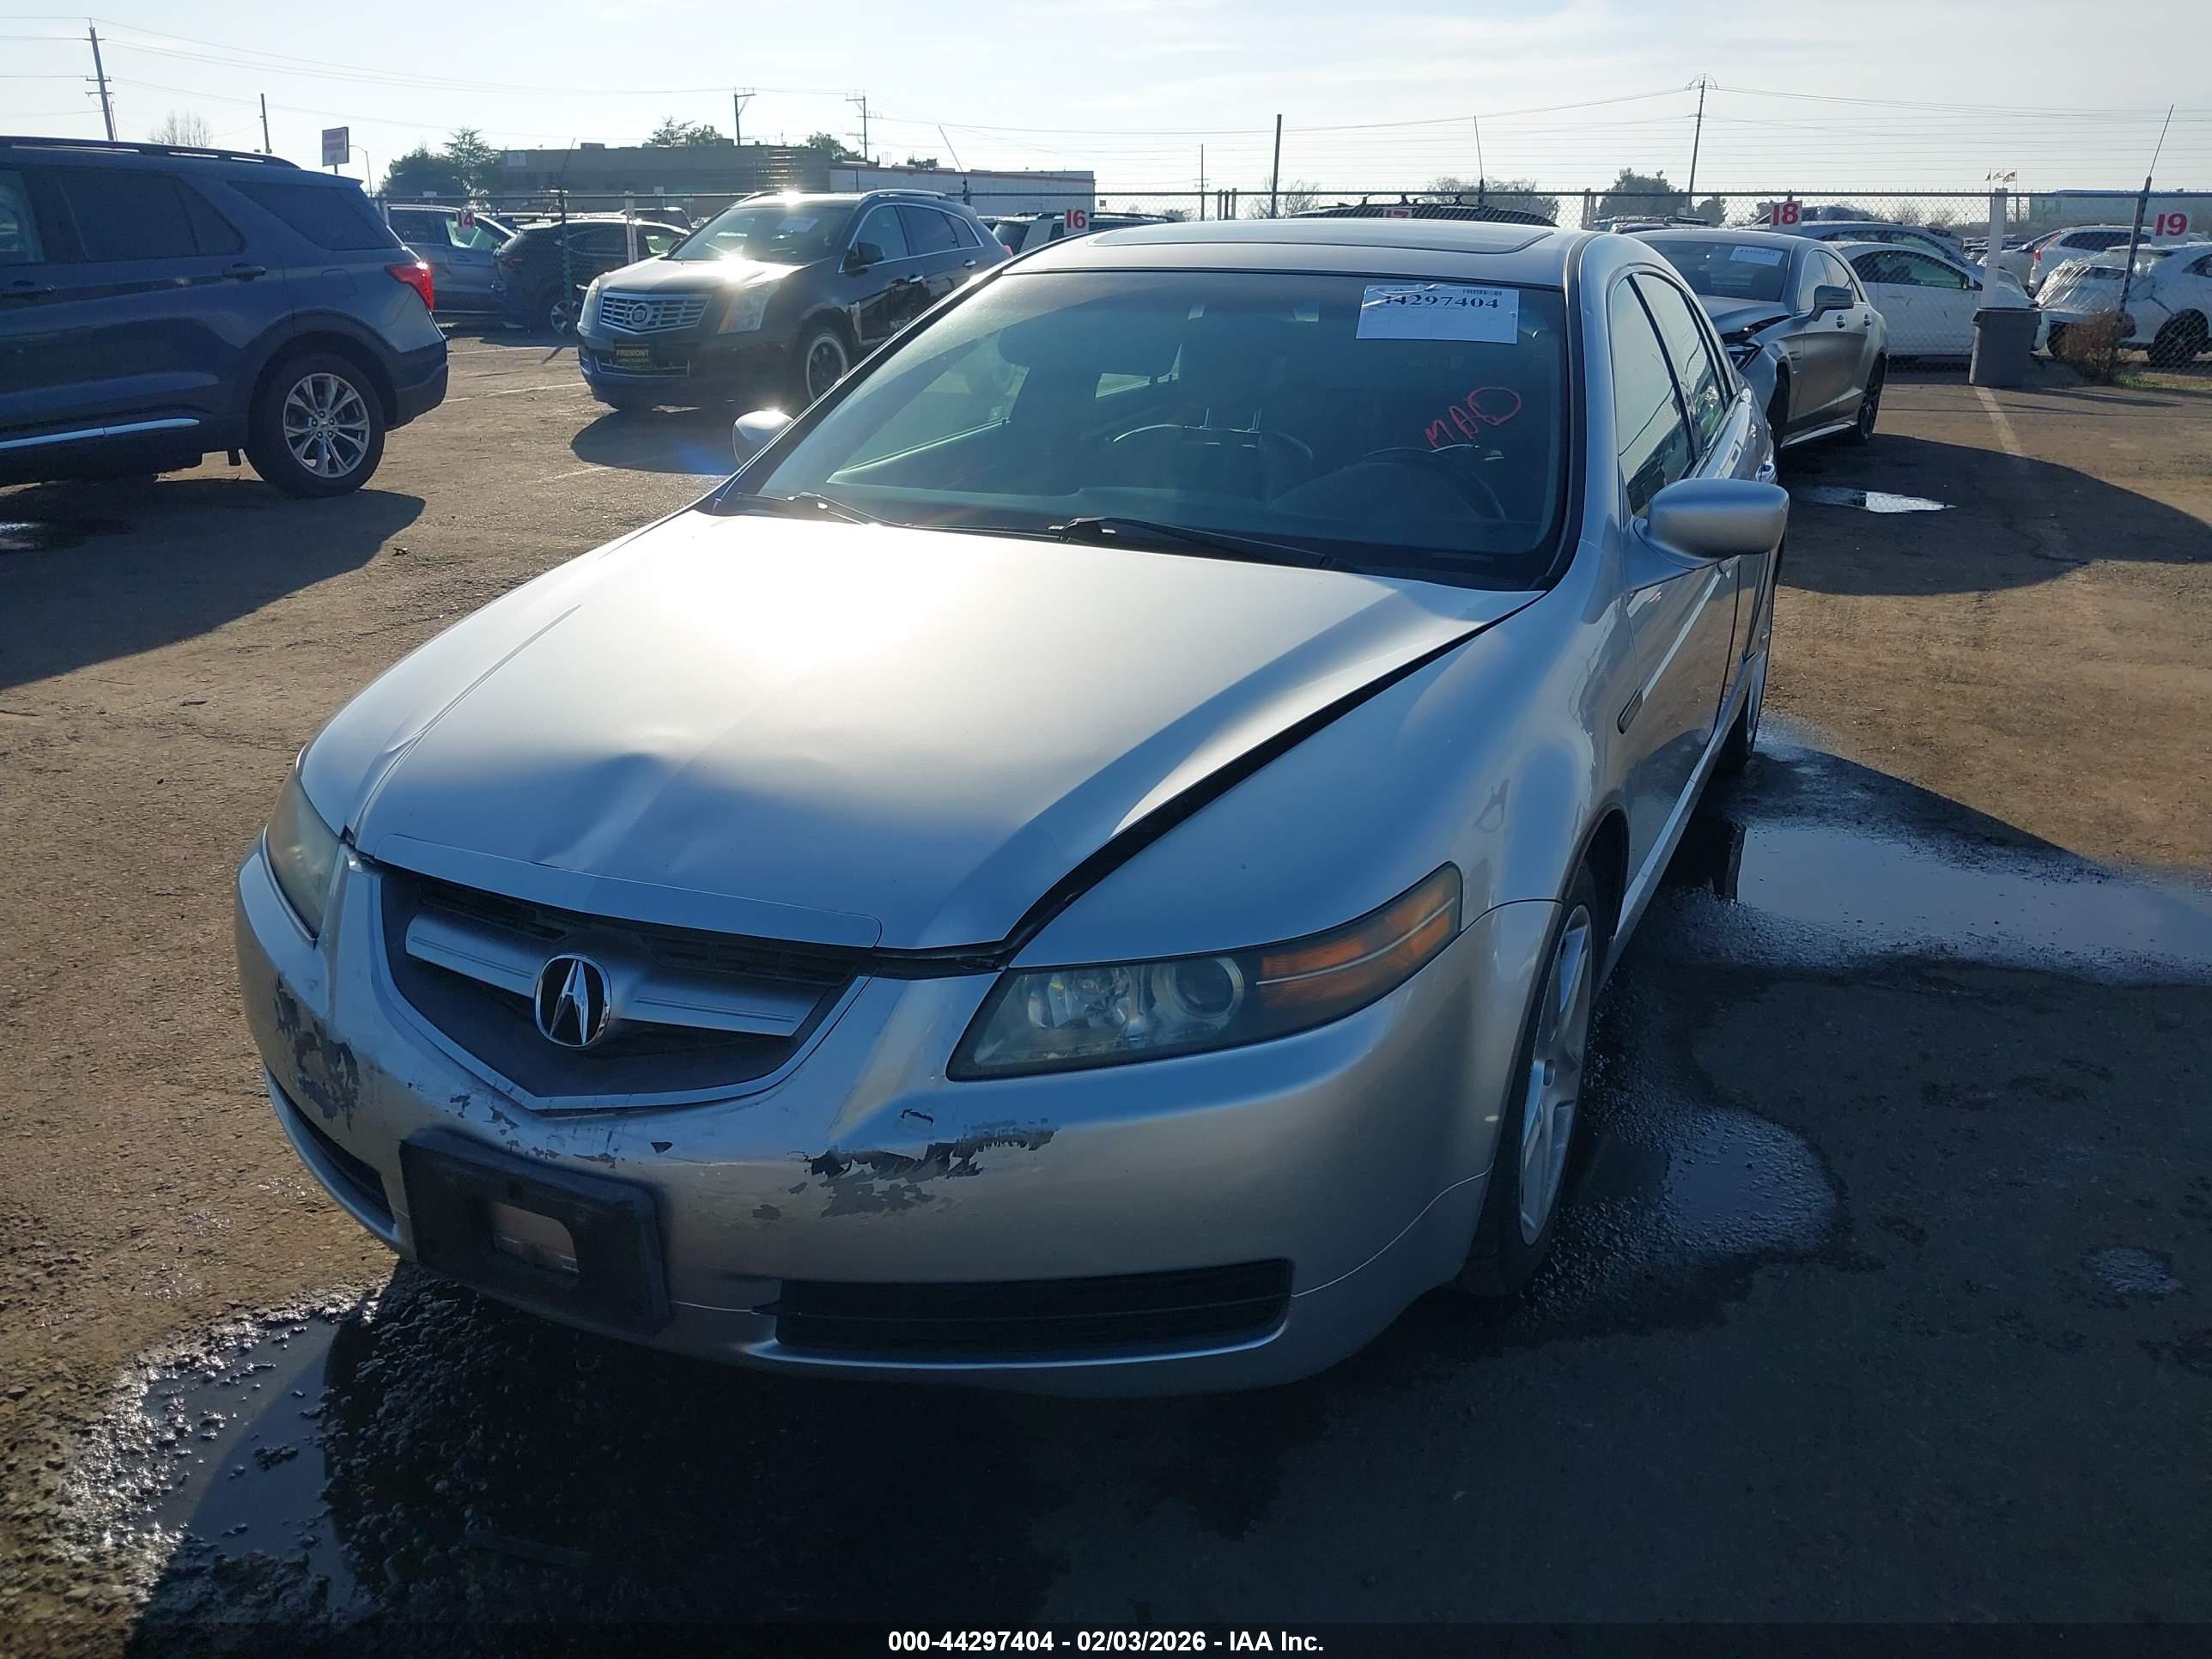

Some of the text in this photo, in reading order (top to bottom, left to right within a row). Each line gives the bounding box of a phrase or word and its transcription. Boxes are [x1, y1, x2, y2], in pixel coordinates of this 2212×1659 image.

[458, 210, 474, 228] 14
[1066, 209, 1086, 228] 16
[1772, 203, 1799, 226] 18
[2155, 213, 2187, 236] 19
